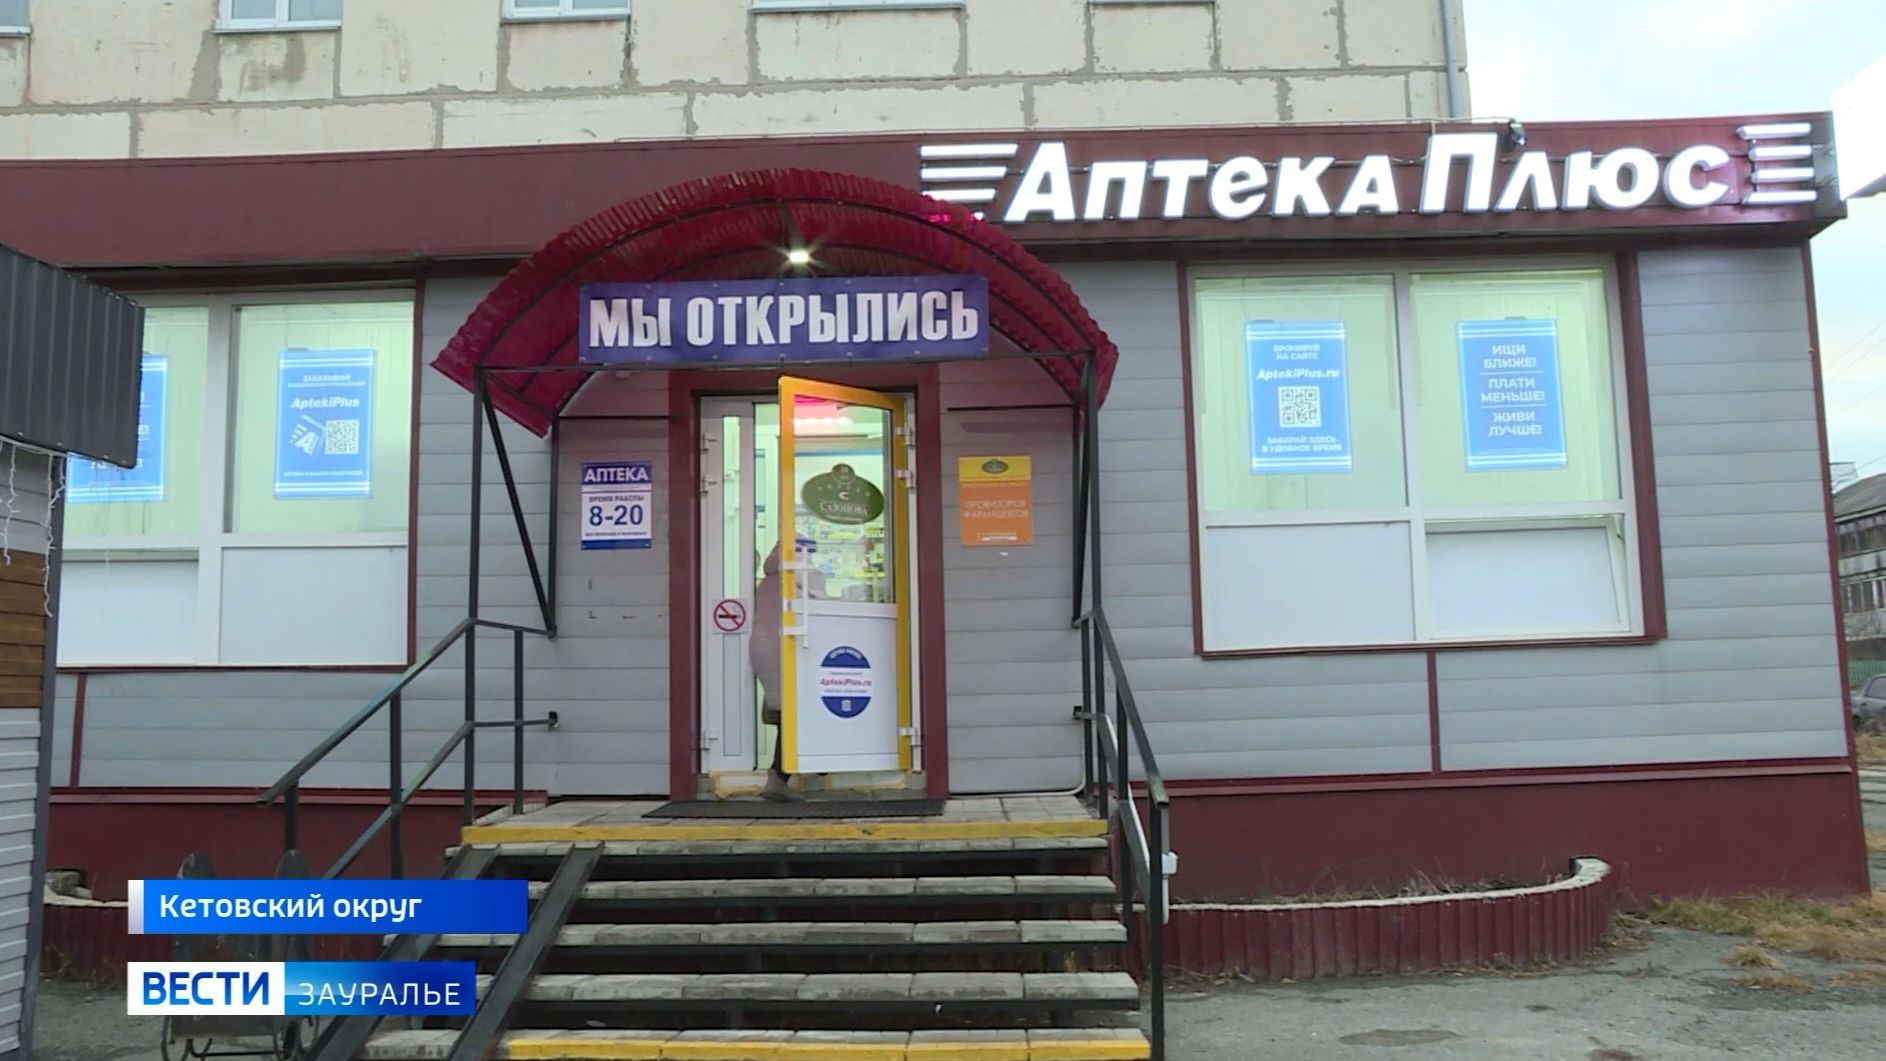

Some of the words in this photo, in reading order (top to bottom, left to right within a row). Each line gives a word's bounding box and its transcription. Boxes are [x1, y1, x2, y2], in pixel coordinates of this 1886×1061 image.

[589, 297, 672, 348] МЫ
[686, 290, 979, 346] ОТКРЫЛИСЬ
[1290, 351, 1318, 360] САЙТЕ
[1492, 344, 1526, 356] ИЩИ
[1483, 357, 1537, 369] БЛИЖЕ!
[1256, 367, 1341, 381] AptekiPlus.ru
[1488, 377, 1536, 390] ПЛАТИ
[1480, 390, 1545, 403] МЕНЬШЕ!
[291, 396, 361, 411] AptekiPlus
[1492, 410, 1536, 423] ЖИВИ
[1488, 424, 1543, 437] ЛУЧШЕ!
[584, 467, 649, 482] АПТЕКА
[589, 495, 613, 503] ВРЕМЯ
[615, 494, 644, 502] РАБОТЫ
[589, 504, 643, 526] 8-20
